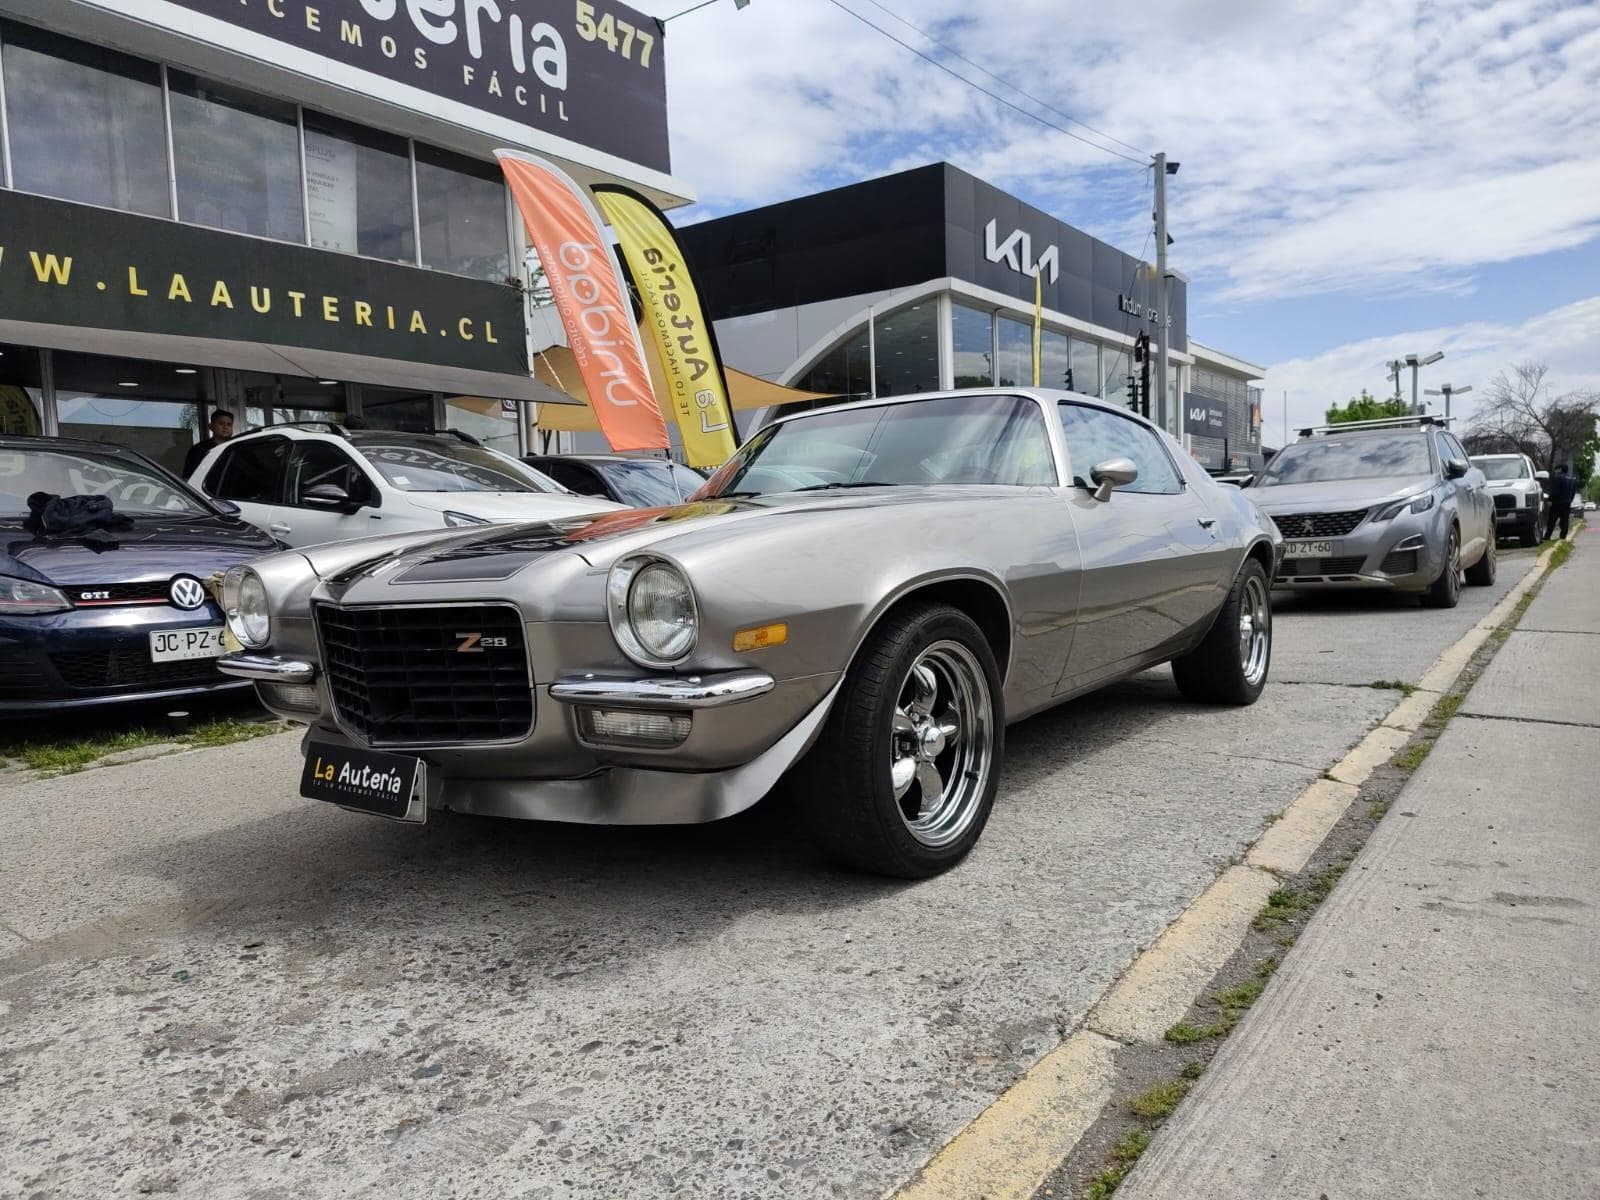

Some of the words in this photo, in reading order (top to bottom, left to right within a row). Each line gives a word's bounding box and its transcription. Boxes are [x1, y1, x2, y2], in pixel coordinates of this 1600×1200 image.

[240, 0, 428, 70] CEMOS
[462, 65, 570, 122] FÁCIL
[358, 0, 567, 91] ería
[575, 0, 654, 69] 5477
[984, 217, 1060, 286] KIA
[0, 246, 499, 344] W.LAAUTERIA.CL
[80, 591, 111, 600] GTI
[455, 632, 508, 653] Z28
[314, 756, 335, 781] La
[338, 761, 402, 794] Autería
